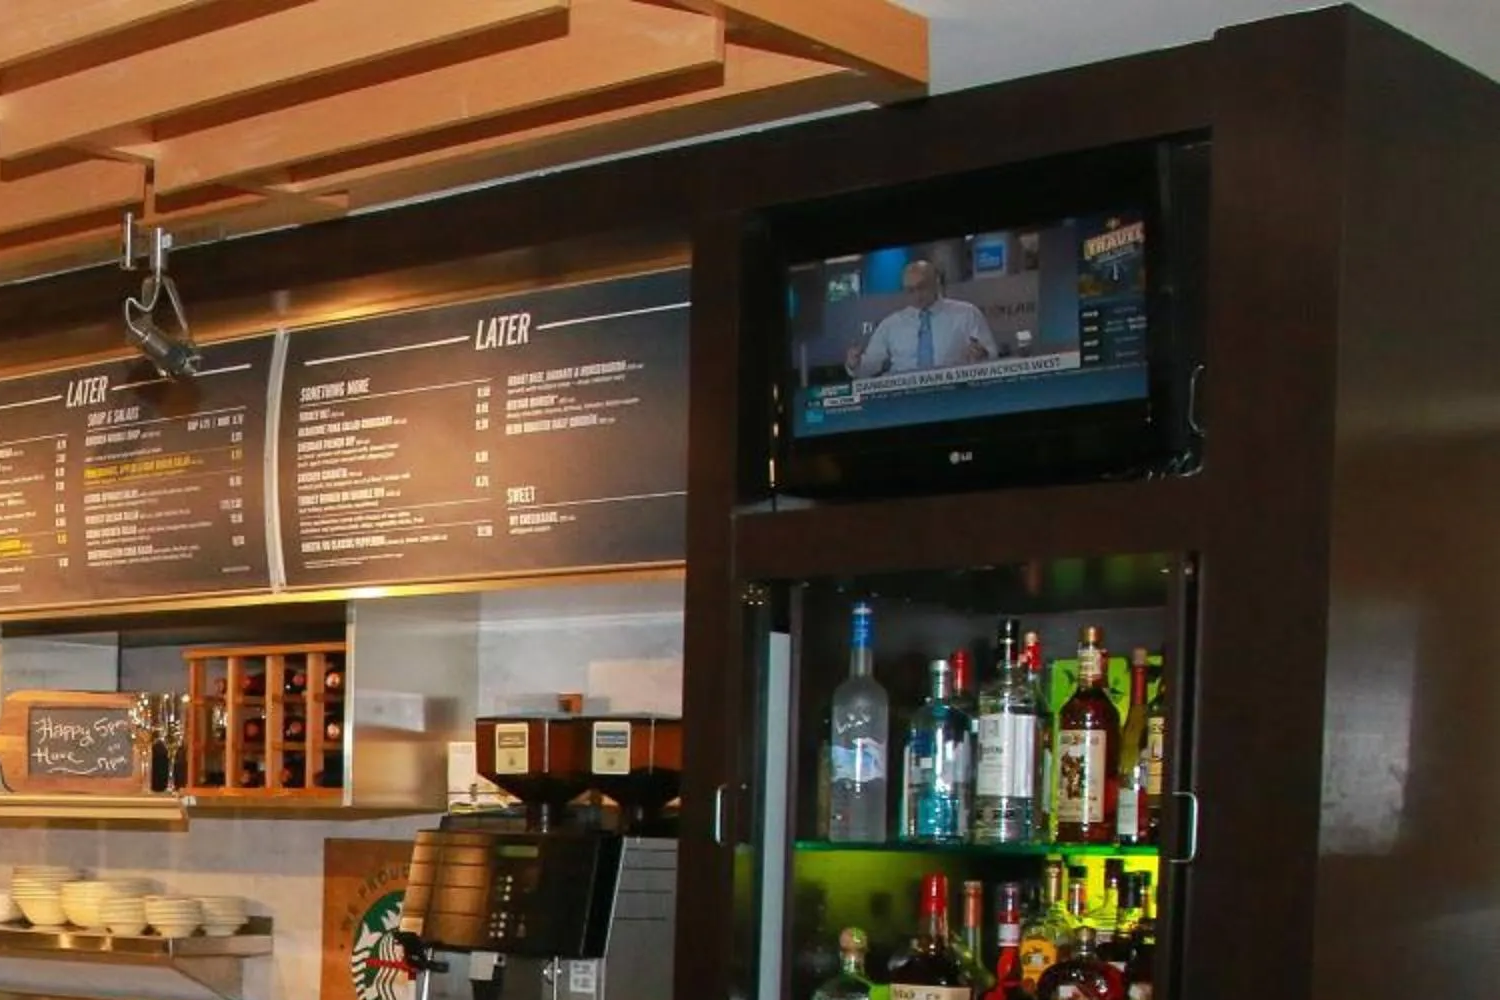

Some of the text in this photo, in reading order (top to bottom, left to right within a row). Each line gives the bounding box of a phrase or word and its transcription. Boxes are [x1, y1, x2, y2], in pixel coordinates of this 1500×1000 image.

[475, 313, 531, 350] LATER
[65, 375, 108, 408] LATER
[507, 486, 535, 504] SWEET
[32, 715, 95, 747] Happy
